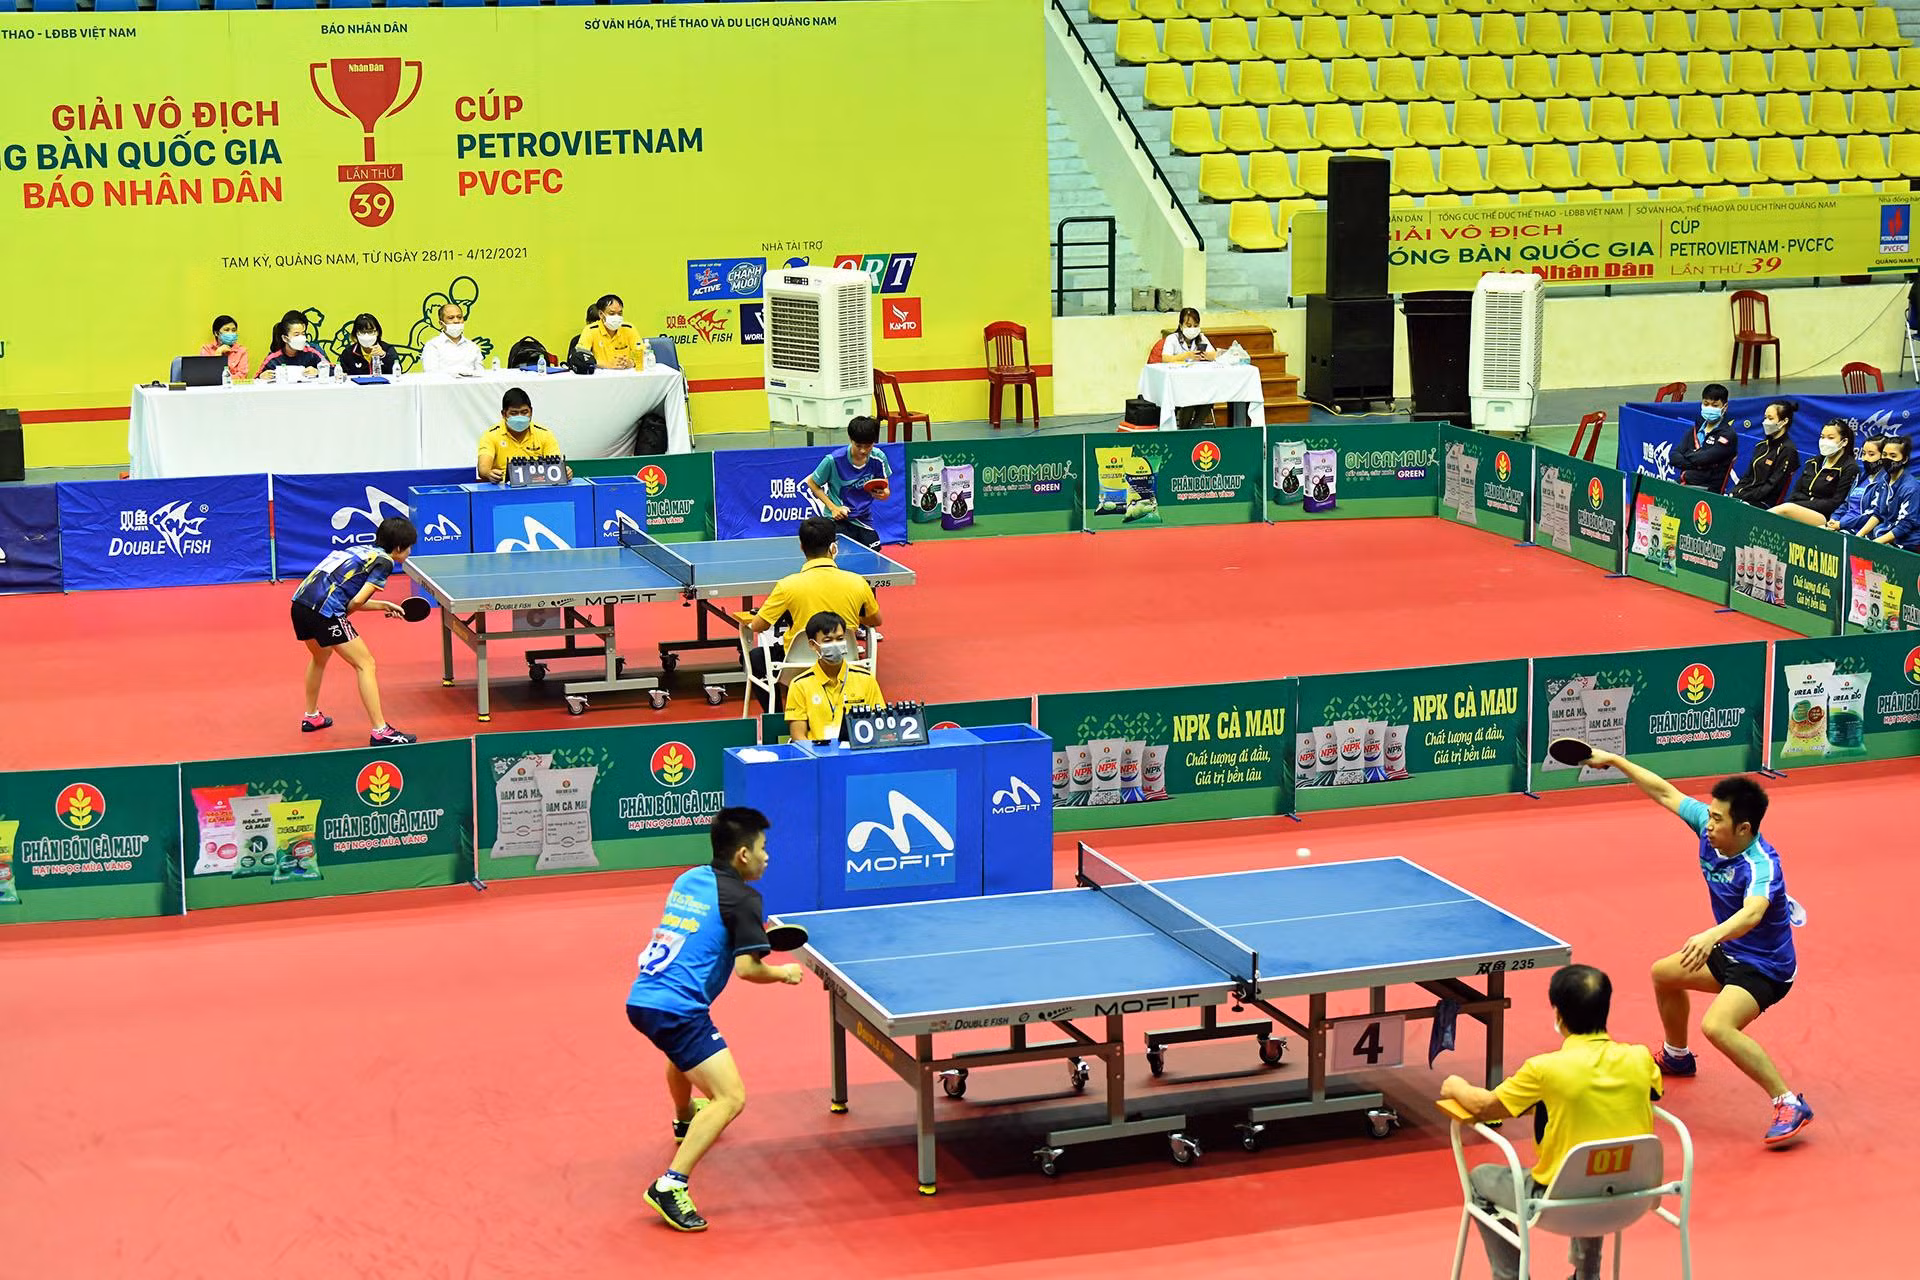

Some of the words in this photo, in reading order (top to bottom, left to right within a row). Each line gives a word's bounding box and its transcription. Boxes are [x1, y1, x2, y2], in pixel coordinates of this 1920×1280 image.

[321, 22, 345, 34] BÁO
[348, 22, 381, 33] NHÂN
[384, 21, 408, 33] DÂN
[584, 17, 600, 30] SỞ
[602, 17, 625, 29] VĂN
[627, 17, 654, 30] HÓA,
[656, 16, 677, 28] THỂ
[679, 18, 709, 28] THAO
[711, 16, 725, 28] VÀ
[728, 18, 743, 28] DU
[746, 17, 770, 29] LỊCH
[772, 15, 810, 27] QUẢNG
[813, 16, 837, 26] NAM
[1, 29, 34, 39] THAO
[45, 28, 77, 39] LĐBB
[80, 26, 106, 40] VIỆT
[109, 28, 136, 38] NAM
[348, 63, 368, 73] Nhân
[369, 63, 384, 72] Dân
[52, 96, 122, 131] GIẢI
[133, 95, 182, 130] VÔ
[192, 100, 279, 134] ĐỊCH
[455, 88, 523, 122] CÚP
[37, 137, 108, 170] BÀN
[118, 130, 216, 169] QUỐC
[224, 138, 283, 166] GIA
[457, 127, 703, 159] PETROVIETNAM
[346, 165, 369, 180] LẦN
[370, 165, 396, 180] THỨ
[459, 168, 563, 196] PVCFC
[23, 174, 94, 209] BÁO
[104, 170, 201, 207] NHÂN
[213, 170, 283, 203] DÂN
[353, 193, 392, 219] 39
[1604, 207, 1624, 216] NAM
[1818, 201, 1837, 209] NAM
[1440, 224, 1482, 240] VÔ
[1489, 224, 1563, 240] ĐỊCH
[1670, 216, 1700, 235] CÚP
[762, 240, 783, 252] NHÀ
[785, 240, 802, 252] TÀI
[803, 240, 824, 251] TRỢ
[1459, 244, 1511, 263] BÀN
[1519, 238, 1600, 260] QUỐC
[1608, 241, 1654, 257] GIA
[1670, 240, 1779, 257] PETROVIETNAM
[1787, 237, 1834, 252] PVCFC
[222, 257, 249, 268] TAM
[275, 252, 323, 267] QUẢNG
[326, 253, 359, 266] NAM,
[363, 250, 381, 264] TỪ
[384, 249, 418, 263] NGÀY
[422, 250, 454, 262] 28/11
[466, 247, 527, 260] 4/12/2021
[1671, 263, 1704, 276] LẦN
[1710, 262, 1743, 275] THỨ
[1745, 256, 1782, 275] 39
[728, 264, 762, 281] CHANH
[1531, 264, 1600, 281] Nhân
[1604, 262, 1654, 277] Dân
[692, 284, 722, 296] ACTIVE
[889, 320, 917, 331] KAMITO
[711, 332, 733, 343] FISH
[514, 468, 525, 484] 1
[547, 465, 562, 482] 0
[1397, 470, 1425, 478] GREEN
[770, 477, 797, 499] 双魚
[1033, 483, 1060, 492] GREEN
[672, 499, 691, 515] MAU
[760, 504, 813, 523] DOUBLE
[120, 508, 149, 532] 双魚
[108, 537, 166, 557] DOUBLE
[183, 539, 212, 554] FISH
[424, 533, 462, 542] MOFIT
[1788, 541, 1806, 569] NPK
[1807, 545, 1819, 573] CÀ
[1820, 551, 1839, 579] MAU
[874, 580, 891, 588] 235
[494, 602, 518, 611] DOUBLE
[585, 593, 657, 606] MOFIT
[1794, 688, 1812, 696] UREA
[1412, 693, 1448, 723] NPK
[1454, 685, 1477, 719] CÀ
[1480, 687, 1518, 716] MAU
[1877, 691, 1905, 714] PHÂN
[1172, 713, 1212, 743] NPK
[1217, 705, 1241, 740] CÀ
[1245, 708, 1286, 738] MAU
[1649, 709, 1680, 734] PHÂN
[1680, 708, 1702, 731] BÓN
[1702, 706, 1717, 729] CÀ
[1717, 708, 1741, 728] MAU
[854, 719, 874, 744] 0
[874, 717, 885, 730] 0
[886, 716, 897, 729] 0
[900, 716, 921, 740] 2
[1425, 730, 1446, 747] Chất
[1447, 729, 1472, 746] lượng
[1474, 727, 1484, 741] đi
[1485, 724, 1505, 741] đầu,
[1185, 750, 1209, 767] Chất
[1209, 750, 1237, 767] lượng
[1238, 748, 1249, 763] đi
[1249, 744, 1271, 763] đầu,
[1299, 752, 1316, 762] NPK
[1343, 742, 1361, 753] NPK
[1386, 745, 1402, 754] NPK
[1434, 749, 1449, 765] Giá
[1450, 749, 1462, 766] trị
[1463, 744, 1480, 762] bền
[1481, 746, 1496, 760] lâu
[1097, 761, 1118, 773] NPK
[1121, 763, 1138, 774] NPK
[1145, 765, 1161, 775] NPK
[1195, 770, 1212, 786] Giá
[1212, 769, 1225, 788] trị
[1226, 766, 1244, 783] bền
[1245, 768, 1262, 783] lâu
[619, 792, 656, 819] PHÂN
[657, 789, 683, 817] BÓN
[683, 789, 700, 814] CÀ
[992, 802, 1041, 815] MOFIT
[323, 814, 360, 840] PHÂN
[361, 811, 391, 836] BÓN
[391, 808, 409, 834] CÀ
[409, 809, 438, 832] MAU
[628, 820, 645, 832] HẠT
[645, 818, 672, 829] NGỌC
[672, 816, 693, 827] MÙA
[22, 836, 60, 864] PHÂN
[61, 835, 89, 862] BÓN
[91, 833, 113, 860] CÀ
[113, 835, 143, 859] MAU
[252, 841, 263, 853] N
[333, 841, 351, 853] HẠT
[351, 839, 380, 852] NGỌC
[379, 835, 401, 848] MÙA
[401, 833, 428, 845] VÀNG
[32, 865, 50, 877] HẠT
[50, 864, 82, 876] NGỌC
[82, 860, 103, 873] MÙA
[104, 860, 133, 871] VÀNG
[847, 852, 954, 874] MOFIT
[1511, 958, 1535, 971] 235
[1095, 993, 1200, 1017] MOFIT
[954, 1018, 989, 1030] DOUBLE
[990, 1017, 1010, 1027] FISH
[1352, 1022, 1384, 1064] 4
[1592, 1150, 1625, 1173] 01
